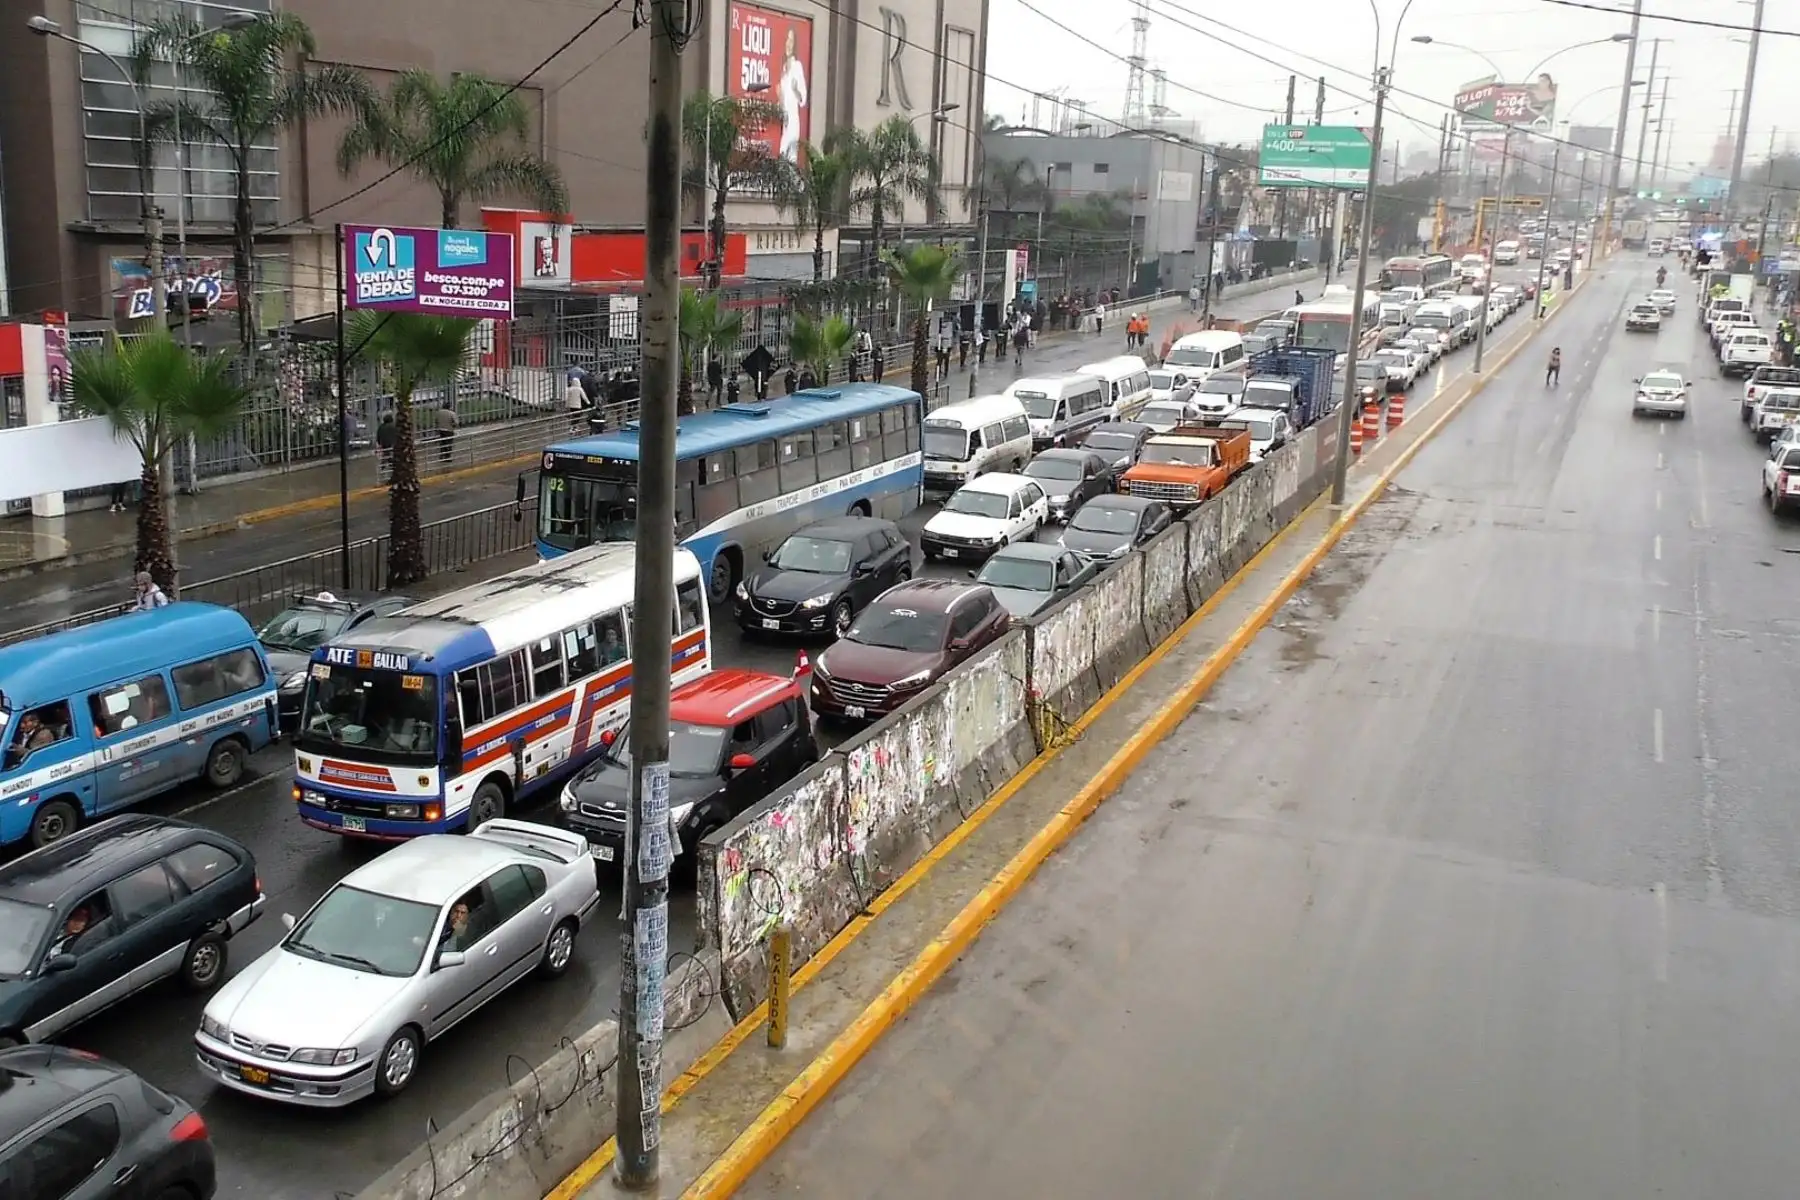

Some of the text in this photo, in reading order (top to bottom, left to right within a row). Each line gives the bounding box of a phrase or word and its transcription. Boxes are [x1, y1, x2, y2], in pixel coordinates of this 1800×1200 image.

[742, 23, 771, 56] LIQUI
[876, 6, 914, 110] R
[355, 267, 415, 284] VENTA DE
[424, 271, 505, 289] besco.com.pe
[359, 279, 414, 299] DEPAS
[440, 284, 488, 297] 637-3200
[327, 647, 354, 664] ATE
[373, 652, 408, 671] CALLAO
